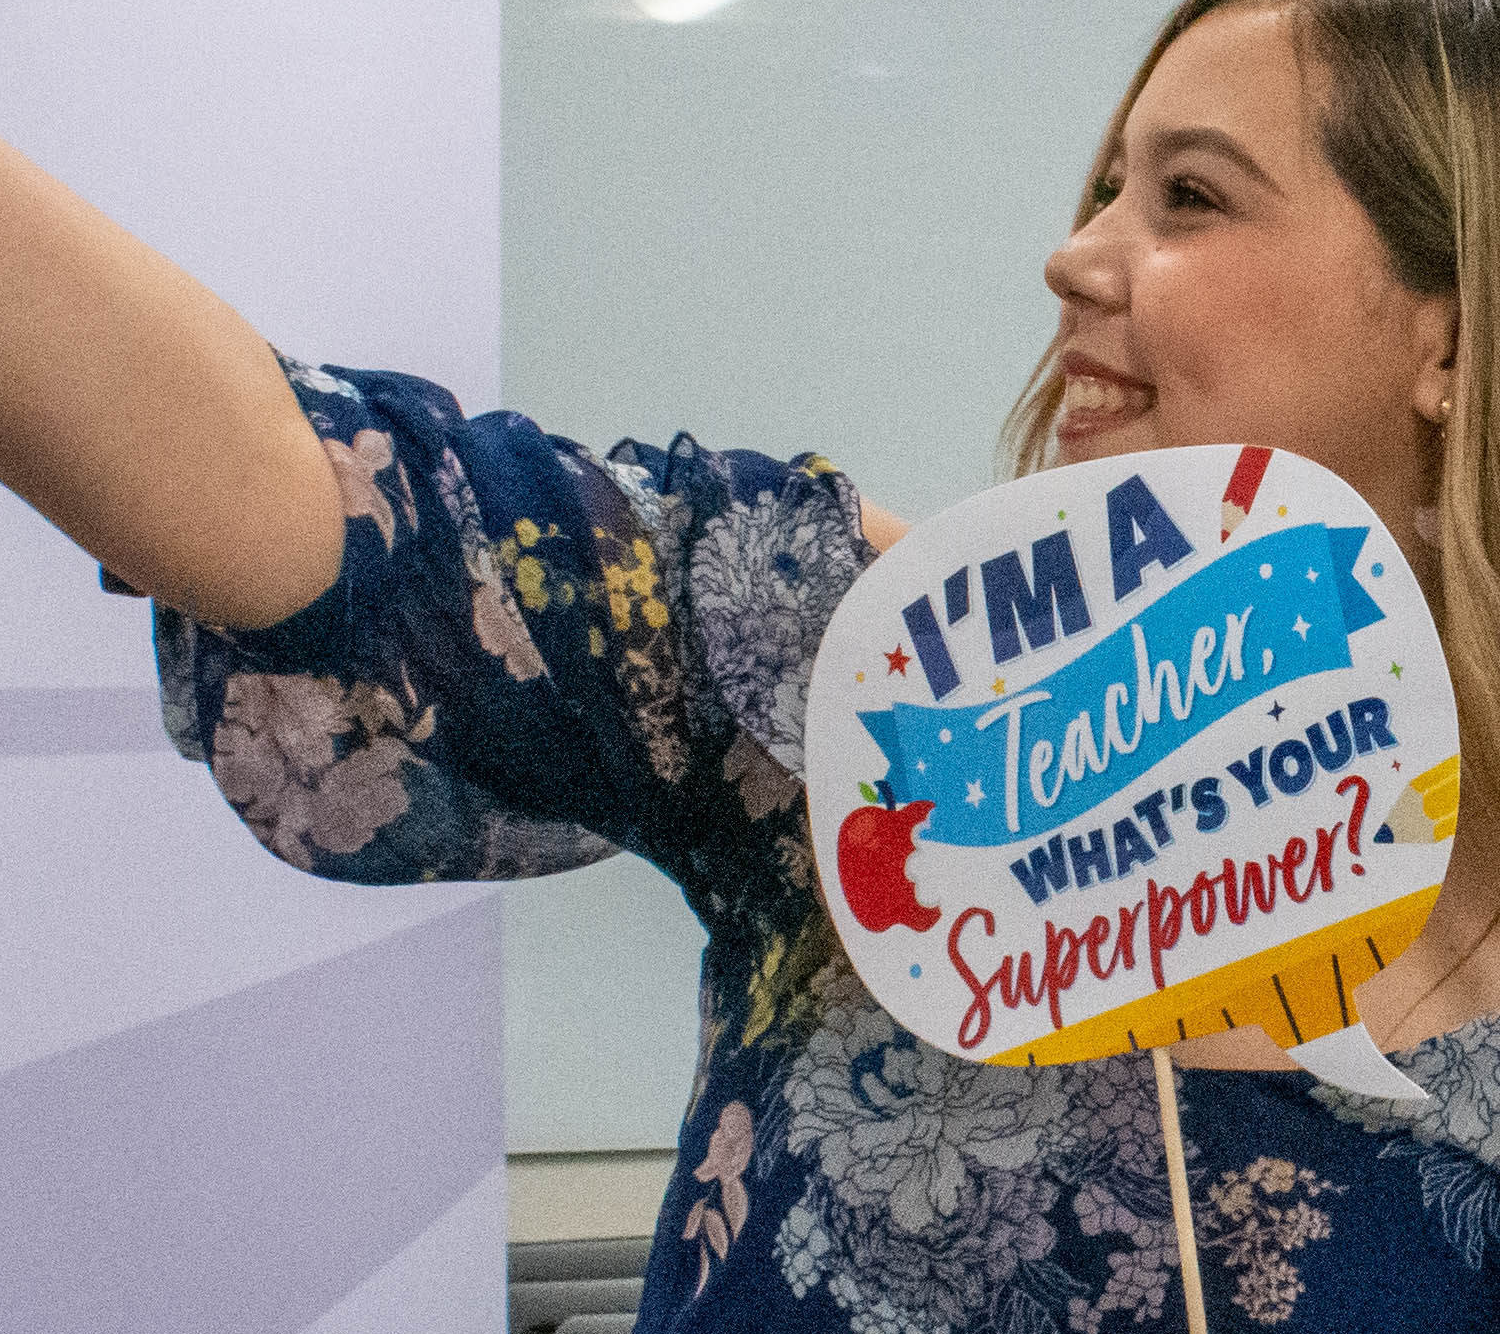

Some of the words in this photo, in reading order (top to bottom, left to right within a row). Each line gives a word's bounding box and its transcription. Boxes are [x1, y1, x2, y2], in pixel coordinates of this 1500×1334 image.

[902, 529, 1095, 701] I'M
[1104, 473, 1197, 604] A
[975, 605, 1275, 833] Teacher,
[1009, 776, 1230, 906] WHAT'S
[1227, 696, 1400, 808] YOUR
[946, 774, 1372, 1050] Superpower?
